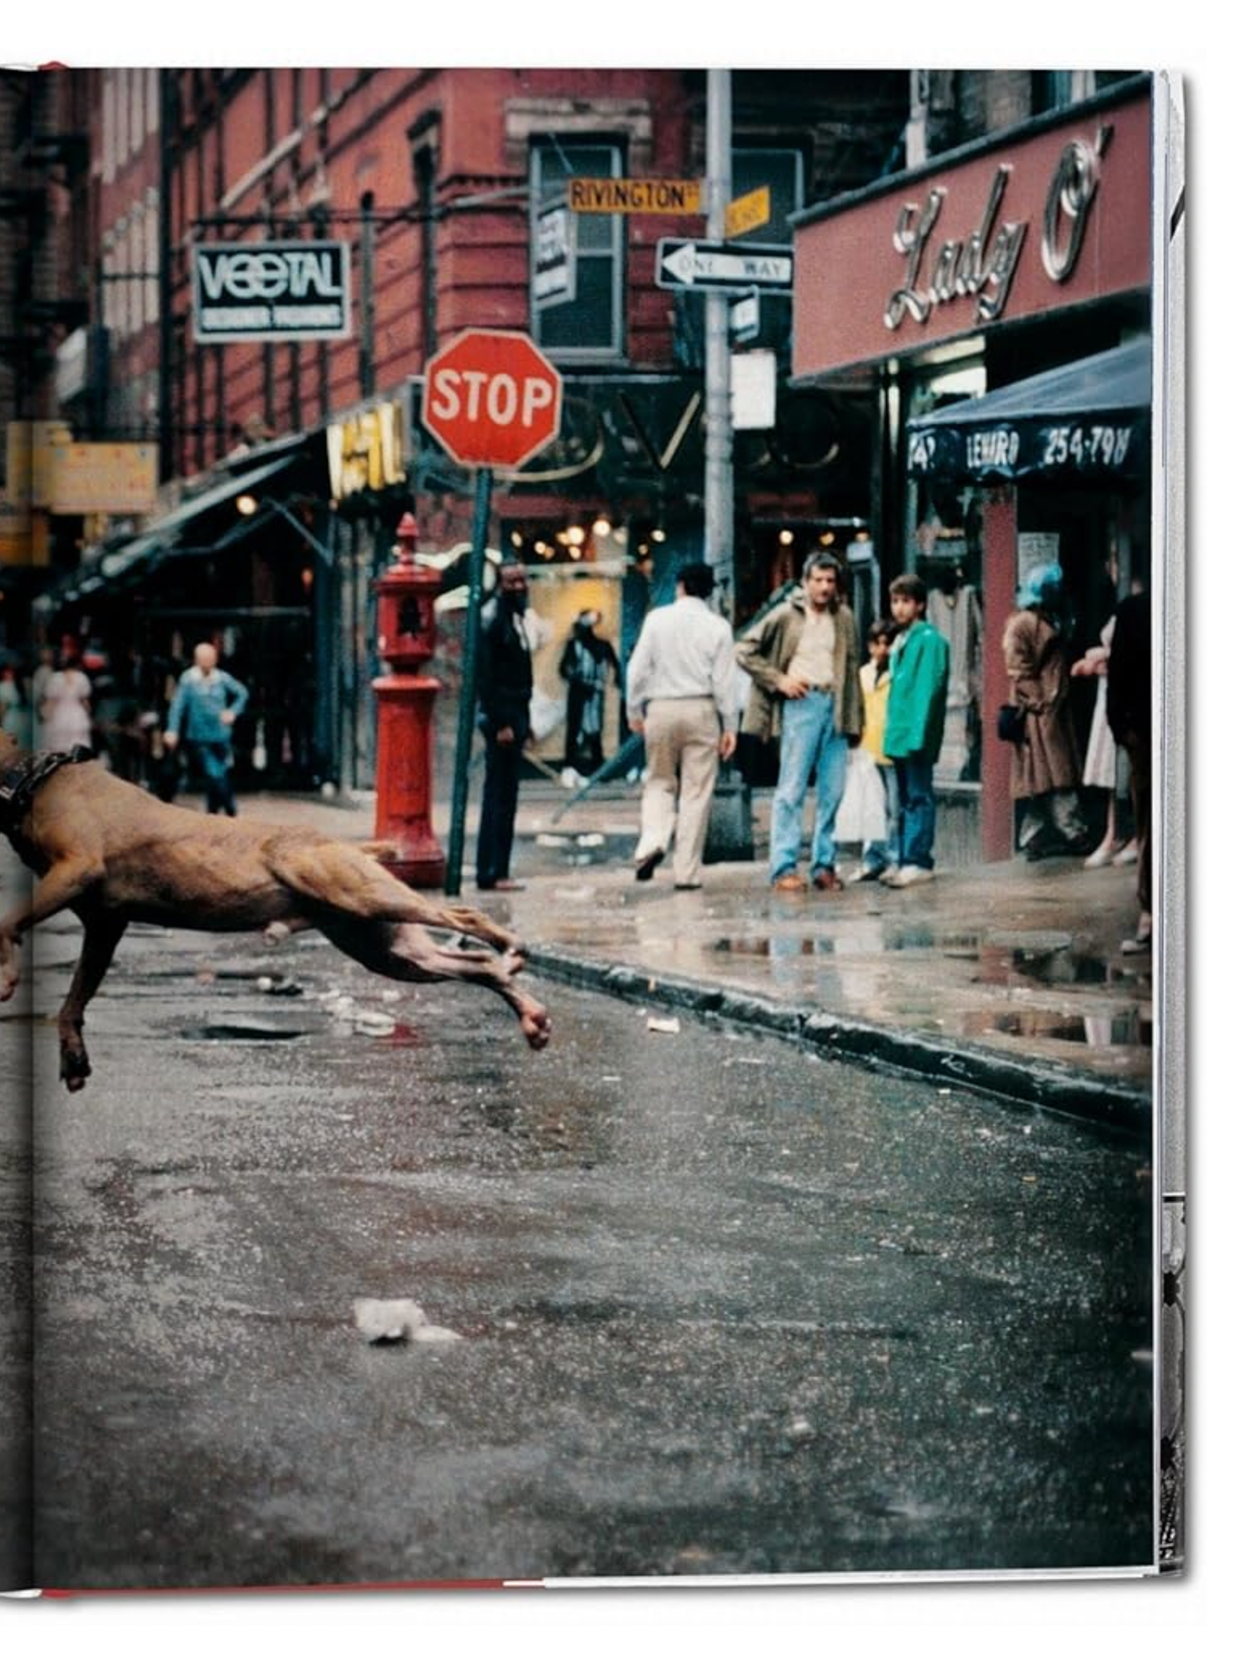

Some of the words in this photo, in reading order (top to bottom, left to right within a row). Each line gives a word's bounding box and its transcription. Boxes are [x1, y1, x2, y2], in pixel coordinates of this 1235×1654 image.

[571, 180, 685, 209] RIVINGTON
[884, 162, 1029, 325] Lady
[744, 258, 782, 277] WAY
[431, 369, 553, 428] STOP
